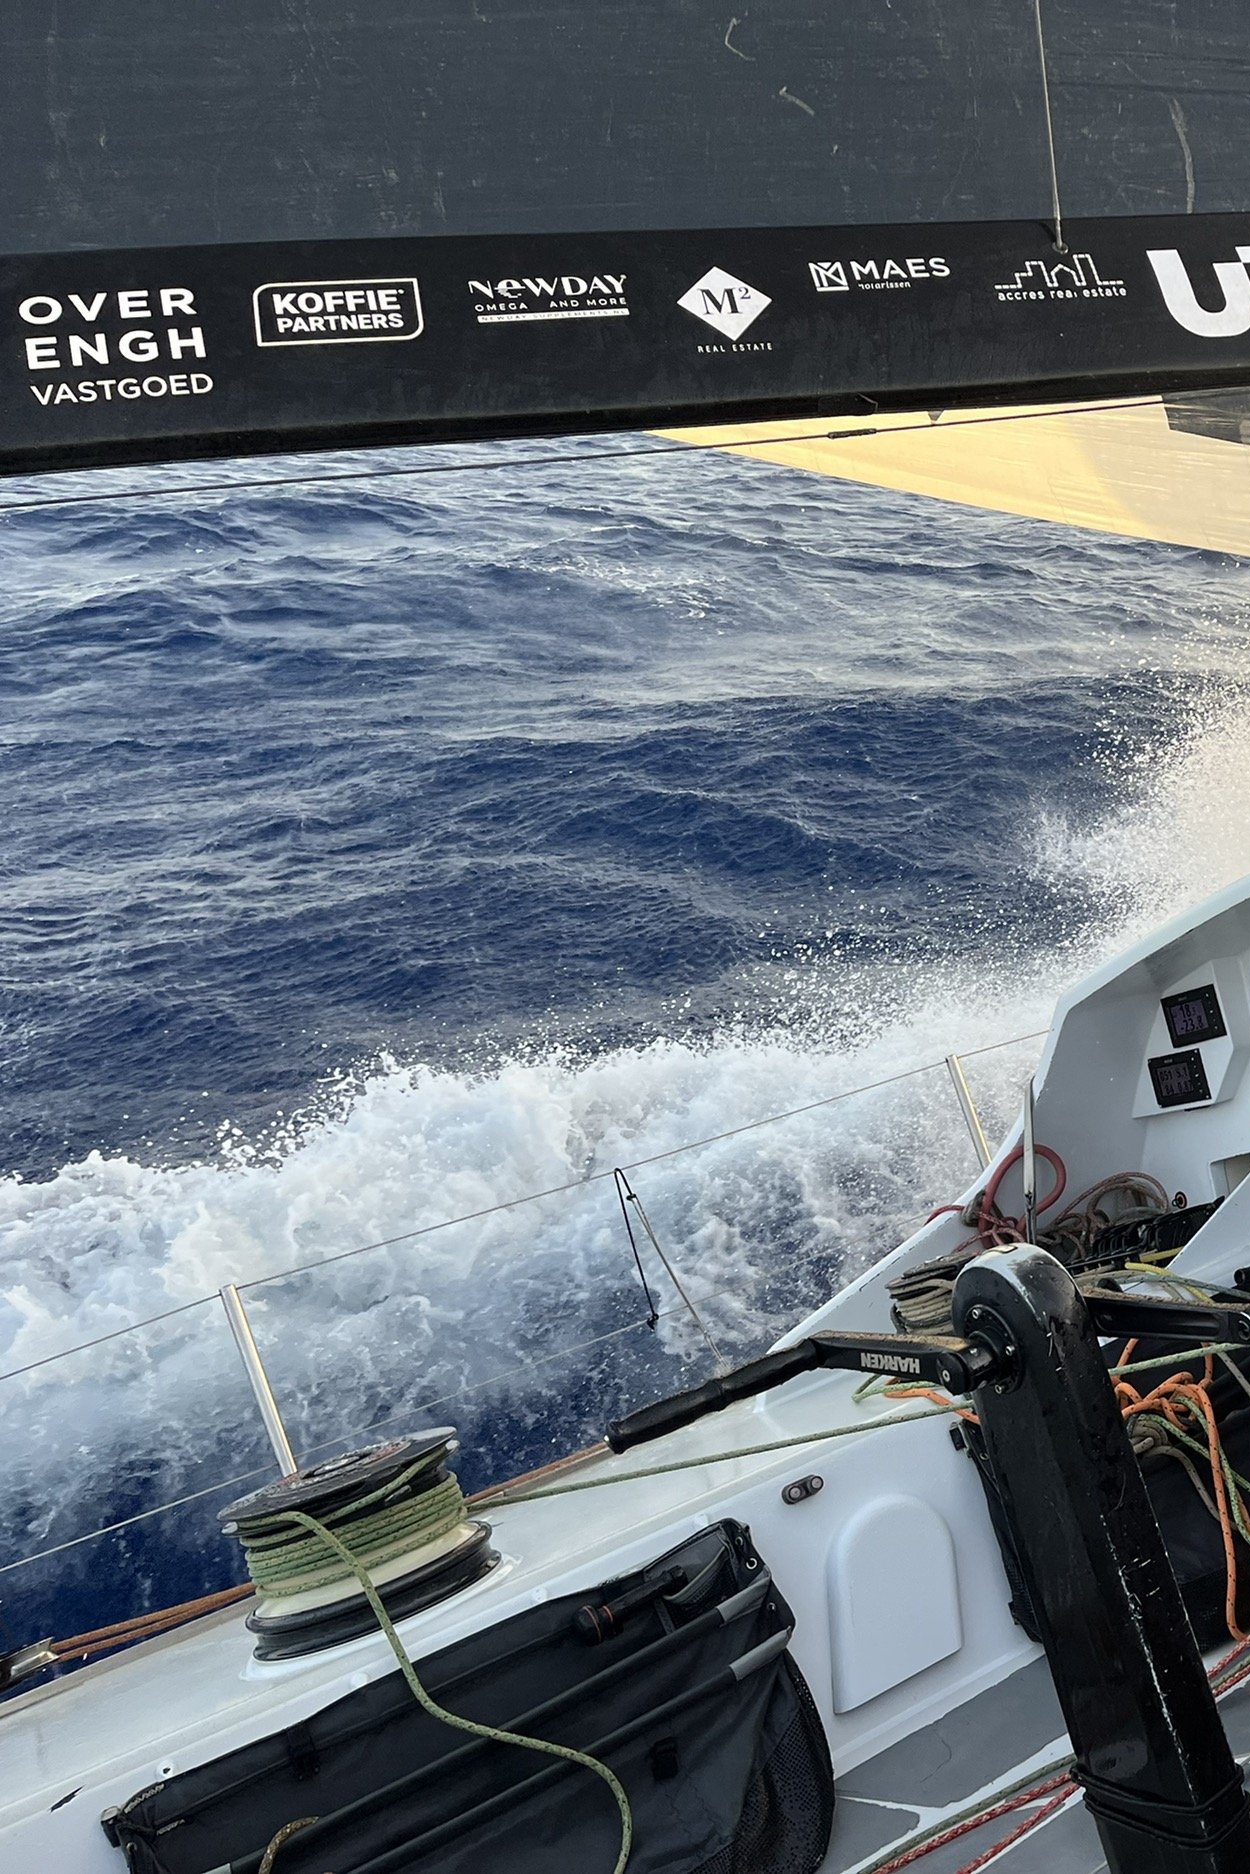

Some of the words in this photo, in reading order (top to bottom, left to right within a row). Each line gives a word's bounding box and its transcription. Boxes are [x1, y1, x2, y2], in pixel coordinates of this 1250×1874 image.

[850, 257, 951, 280] MAES
[272, 290, 401, 315] KOFFIE
[998, 290, 1045, 300] accres
[1082, 286, 1127, 297] estate
[18, 287, 196, 325] OVER
[475, 303, 528, 312] OMEGA
[549, 299, 580, 308] AND
[587, 297, 627, 306] MORE
[277, 312, 404, 333] PARTNERS
[24, 327, 207, 370] ENGH
[697, 344, 726, 353] REAL
[731, 341, 773, 352] ESTATE
[30, 373, 214, 406] VASTGOED
[860, 1352, 921, 1374] HARKEN
